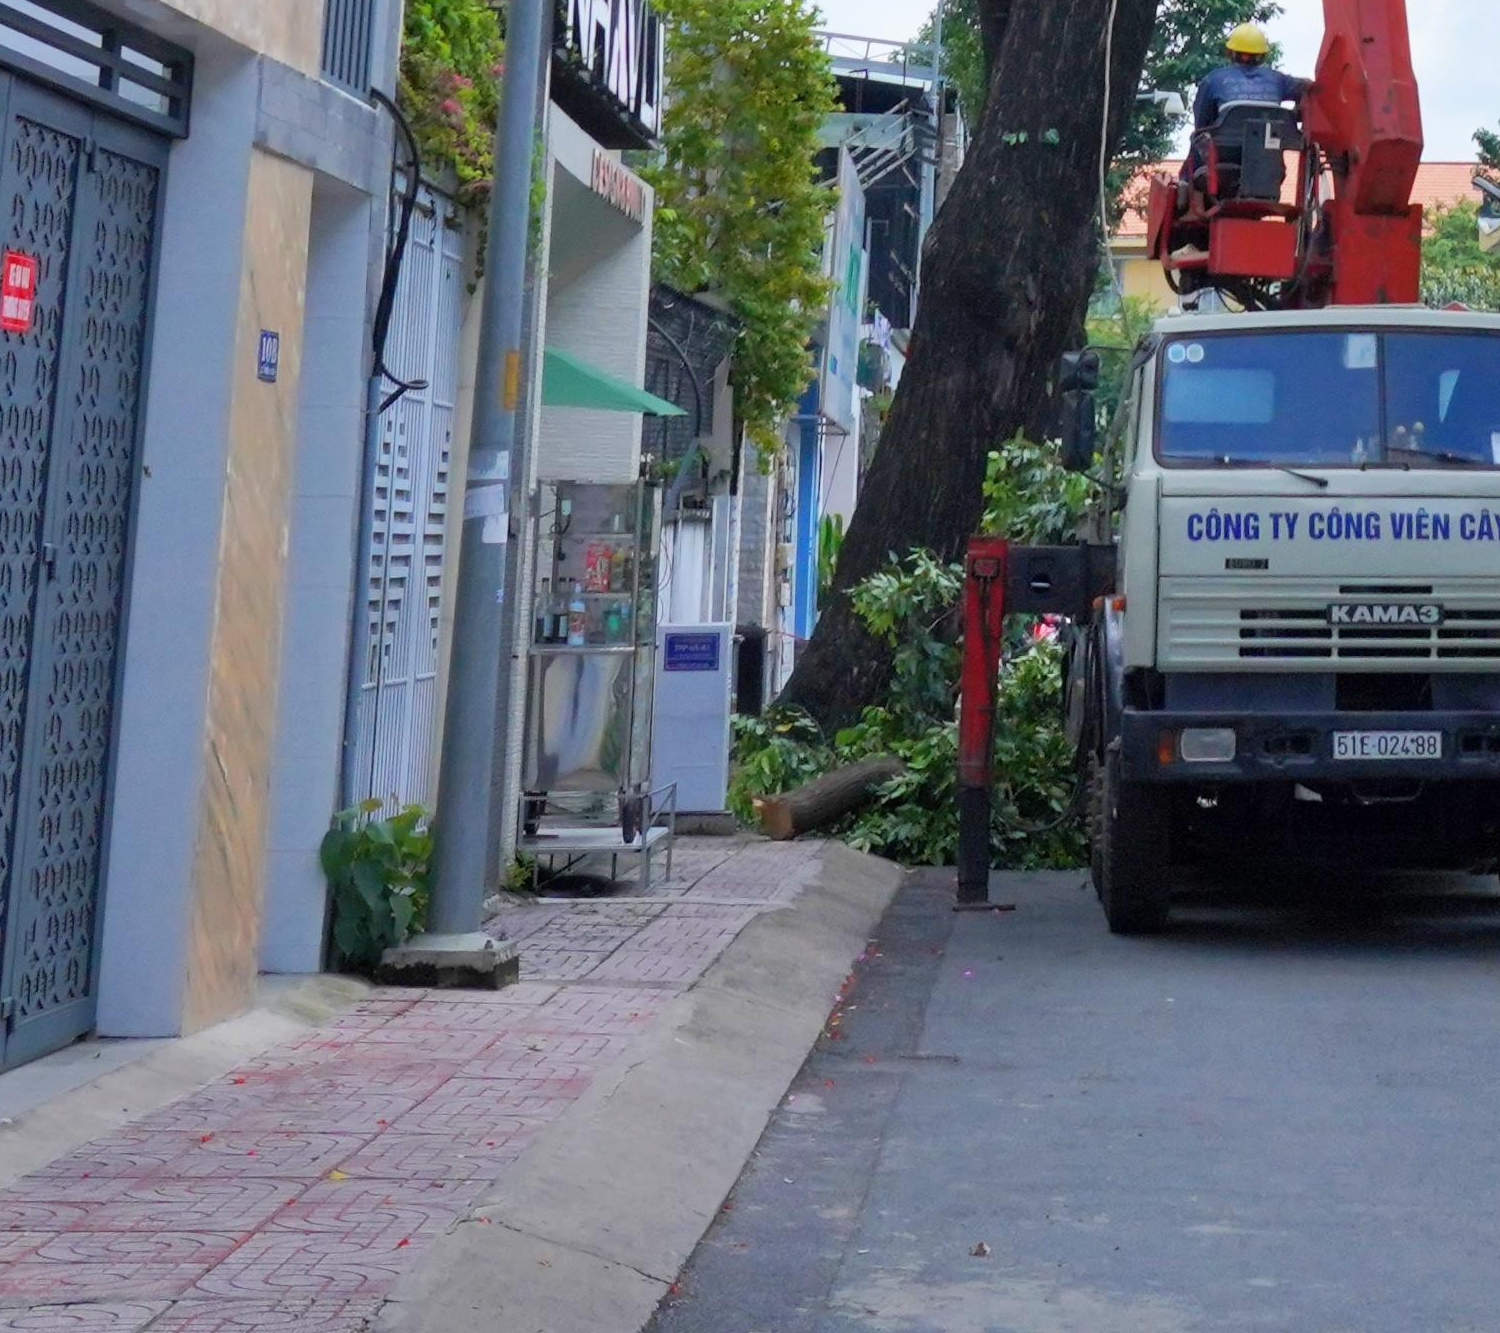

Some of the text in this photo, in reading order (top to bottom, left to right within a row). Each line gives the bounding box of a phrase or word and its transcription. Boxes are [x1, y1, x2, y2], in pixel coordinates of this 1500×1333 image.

[1187, 508, 1261, 542] CÔNG
[1268, 513, 1299, 540] TY
[1307, 507, 1382, 541] CÔNG
[1389, 508, 1452, 542] VIÊN
